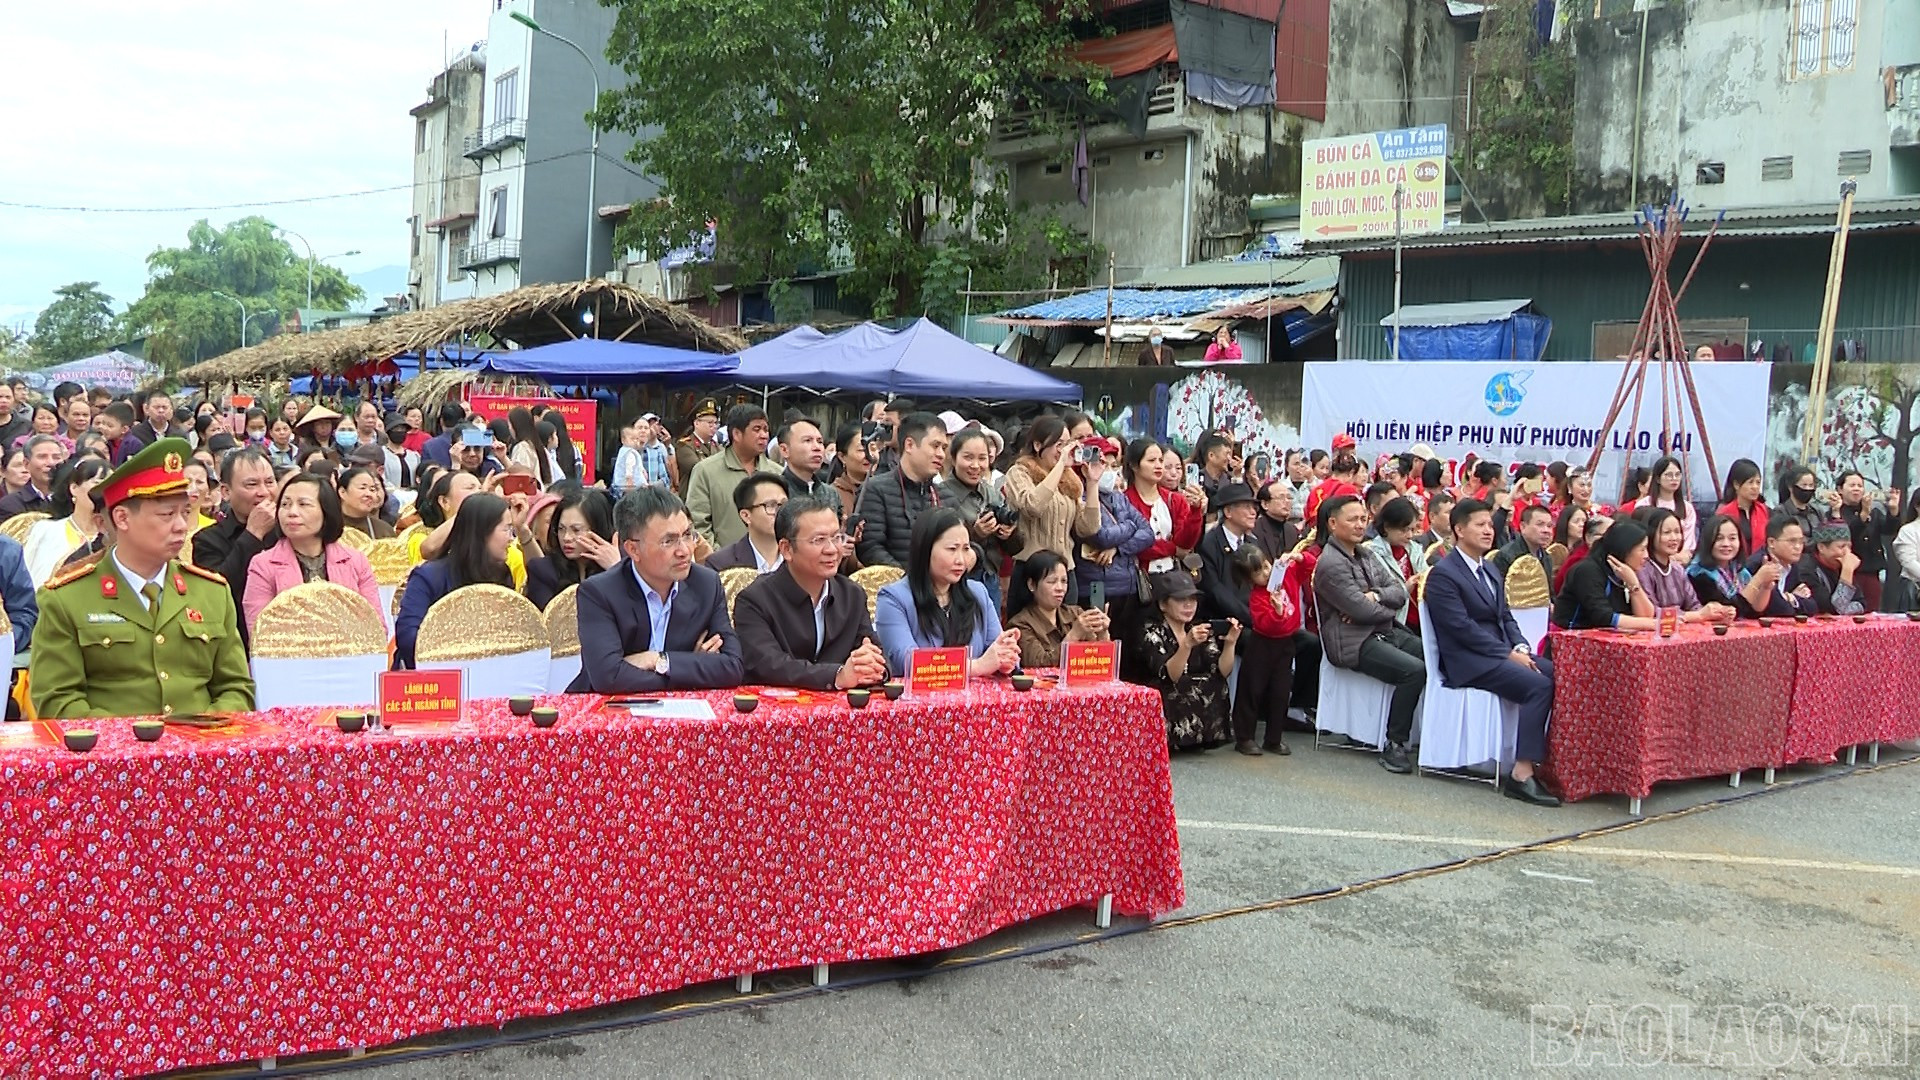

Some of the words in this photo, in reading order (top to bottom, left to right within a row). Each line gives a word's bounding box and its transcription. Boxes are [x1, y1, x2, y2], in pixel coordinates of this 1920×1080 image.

[1382, 132, 1404, 148] An
[1409, 129, 1444, 144] Tâm
[1317, 144, 1347, 164] BÚN
[1351, 139, 1371, 160] CÁ
[1316, 169, 1356, 190] BÁNH
[1360, 169, 1381, 186] ĐA
[1386, 163, 1407, 184] CÁ
[1416, 191, 1438, 212] SỤN
[1363, 221, 1389, 232] 200M
[1346, 418, 1370, 442] HỘI
[1375, 419, 1411, 441] LIÊN
[1415, 420, 1453, 446] HIỆP
[1459, 425, 1494, 448] PHỤ
[1500, 423, 1527, 446] NỮ
[385, 699, 400, 712] CÁC
